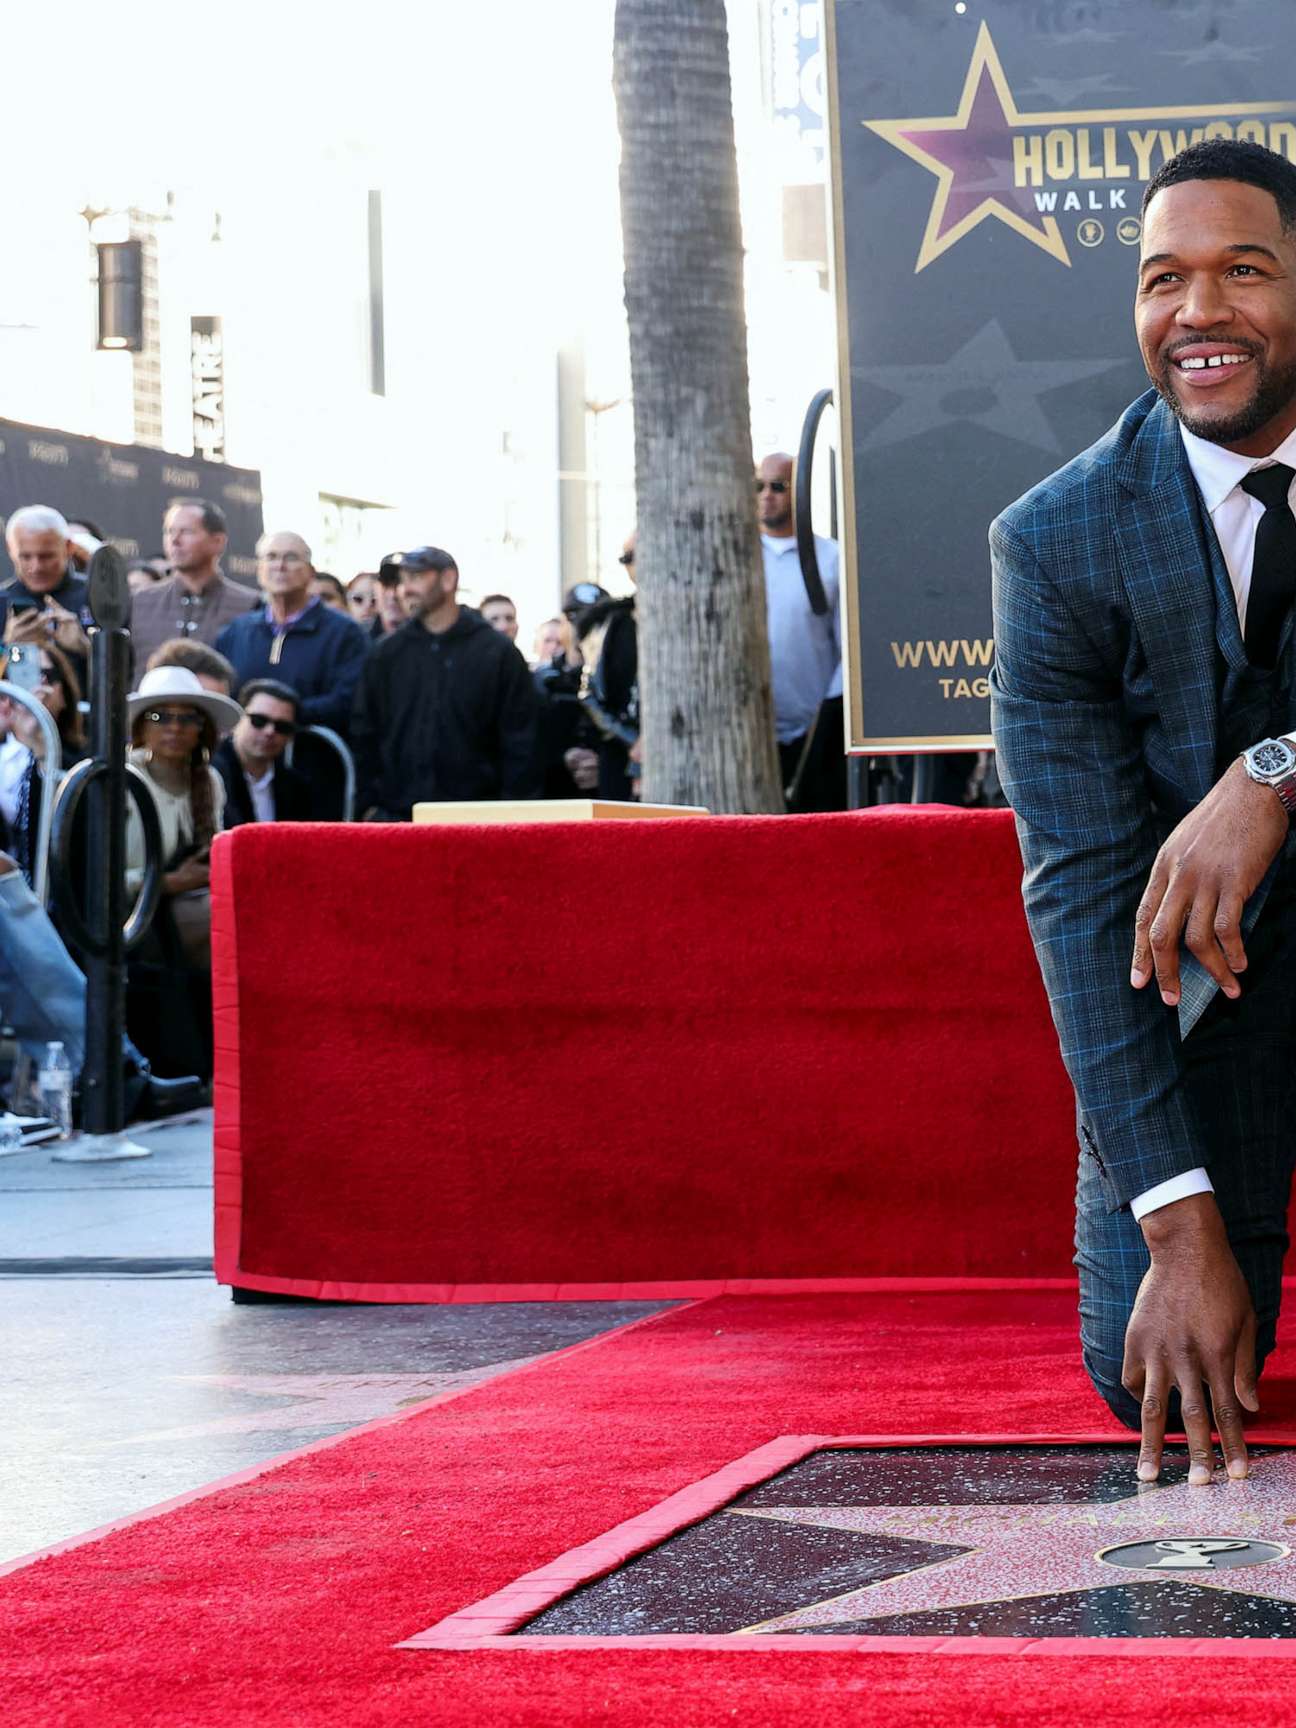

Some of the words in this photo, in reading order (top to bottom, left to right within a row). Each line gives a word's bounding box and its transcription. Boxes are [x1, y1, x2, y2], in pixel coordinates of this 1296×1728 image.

[1034, 189, 1127, 212] WALK
[890, 639, 994, 668] WWW
[938, 677, 990, 698] TAG
